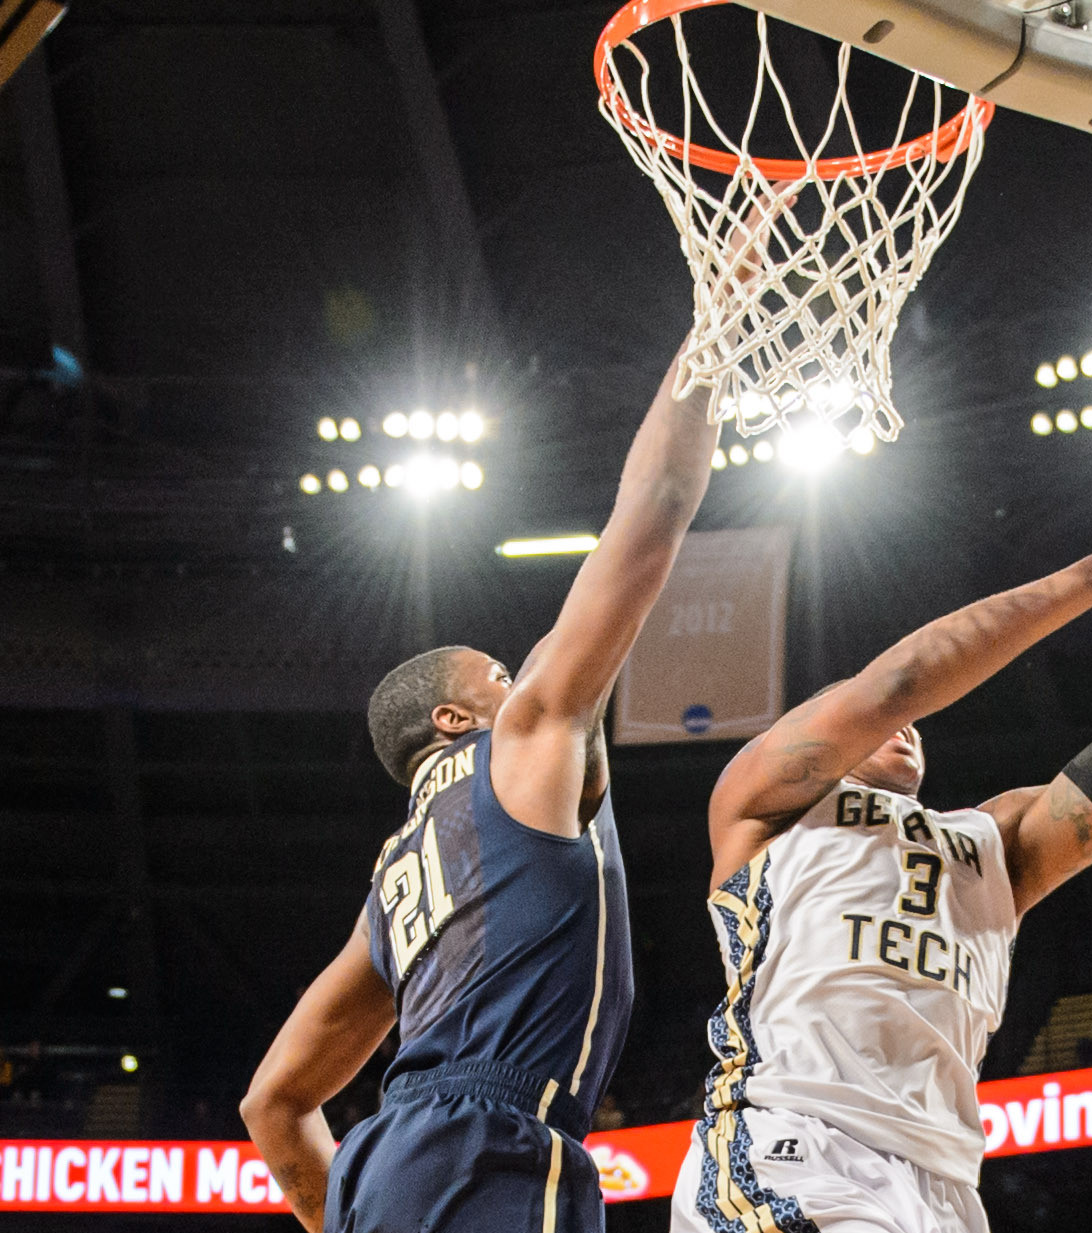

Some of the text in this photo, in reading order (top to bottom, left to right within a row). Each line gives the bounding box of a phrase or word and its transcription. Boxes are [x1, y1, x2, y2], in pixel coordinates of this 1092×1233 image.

[666, 602, 735, 637] 2012
[379, 817, 454, 980] 21
[899, 851, 945, 918] 3
[842, 913, 972, 1000] TECH
[763, 1154, 804, 1163] RUSSELL
[771, 1138, 799, 1155] R
[0, 1147, 285, 1204] HICKEN Mc
